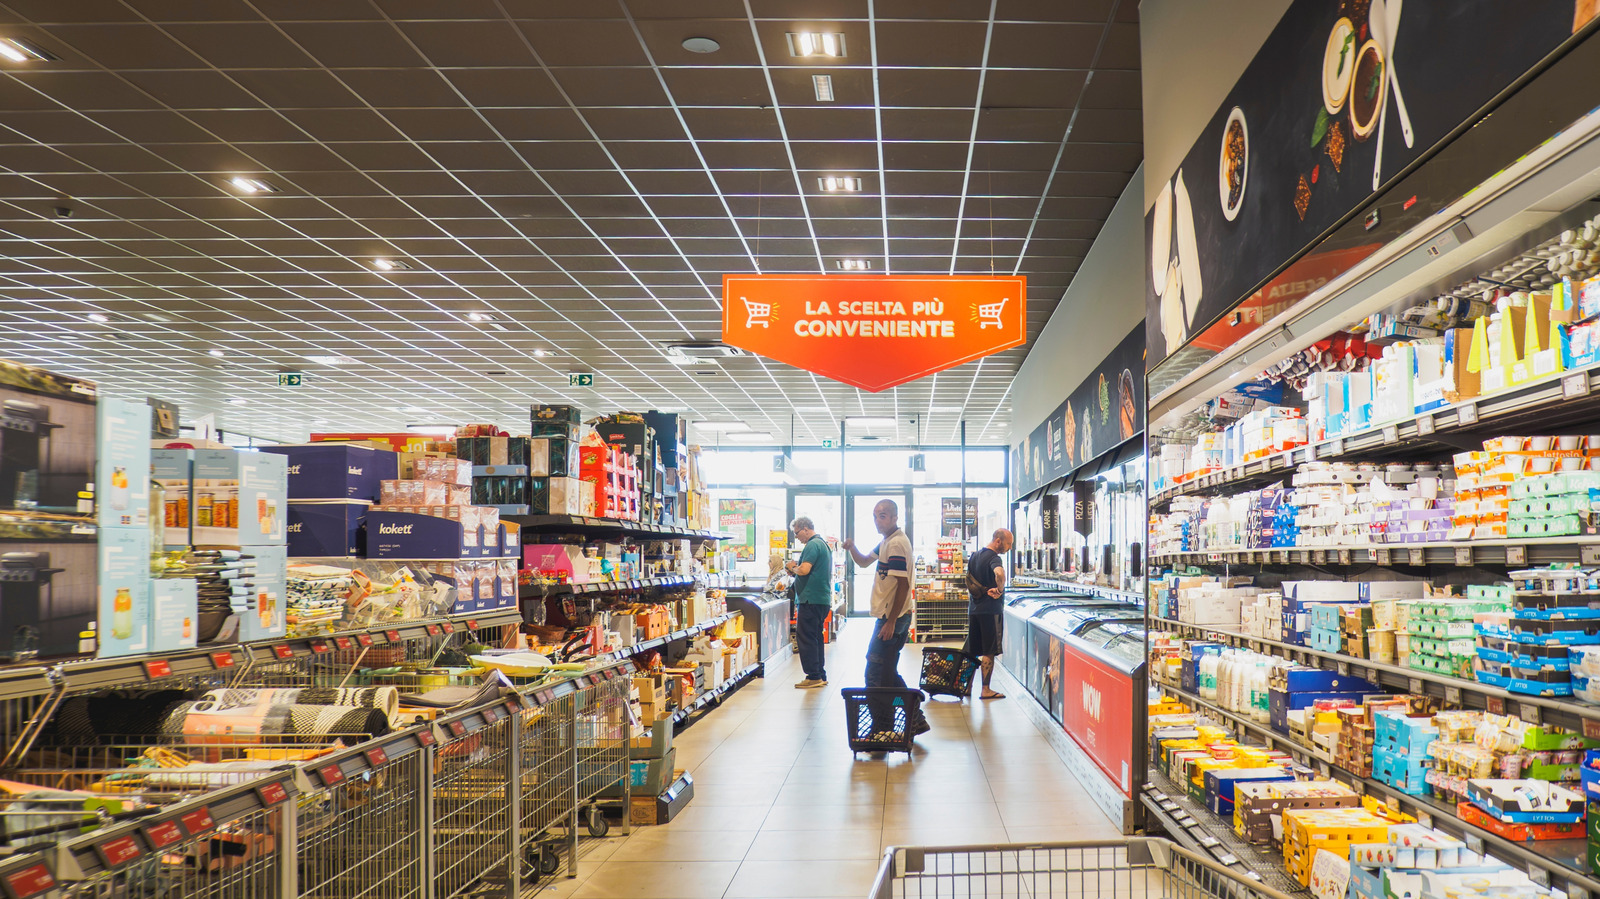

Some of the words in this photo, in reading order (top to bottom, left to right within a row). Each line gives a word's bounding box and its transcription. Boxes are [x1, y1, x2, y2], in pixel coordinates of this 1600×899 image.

[805, 301, 831, 316] LA
[839, 301, 906, 316] SCELTA
[912, 297, 944, 316] PIÙ
[794, 320, 955, 338] CONVENIENTE
[1043, 509, 1051, 529] CARNE
[1075, 500, 1083, 520] PIZZA
[379, 522, 413, 534] kokett
[1082, 680, 1101, 723] WOW
